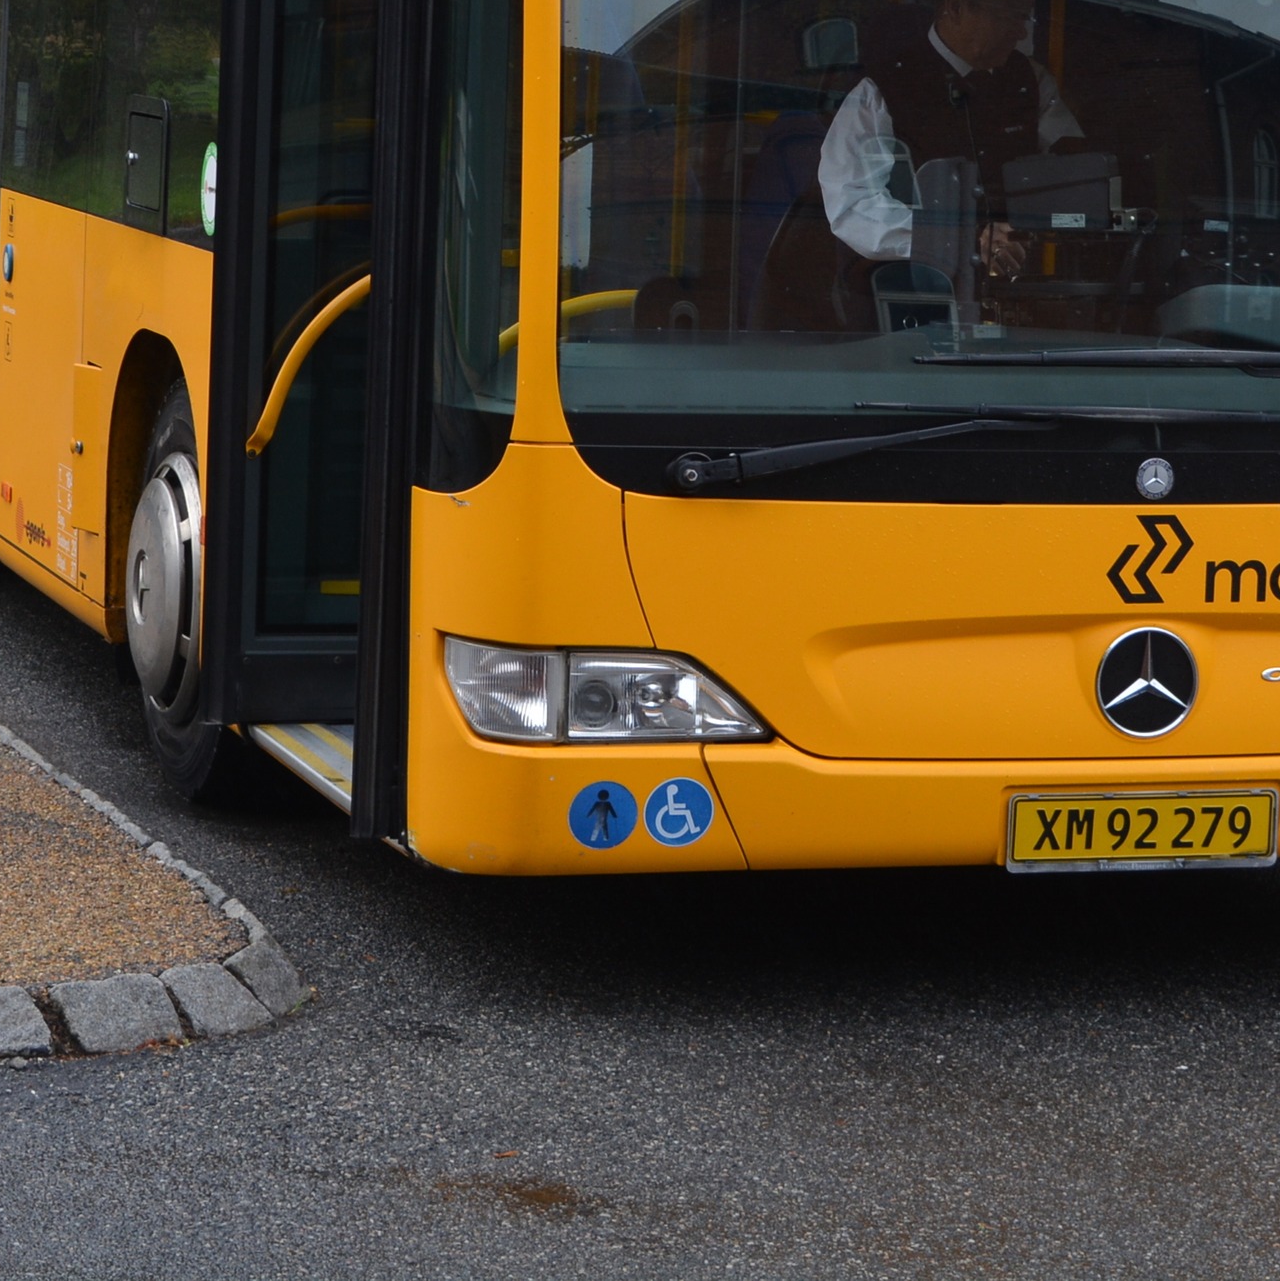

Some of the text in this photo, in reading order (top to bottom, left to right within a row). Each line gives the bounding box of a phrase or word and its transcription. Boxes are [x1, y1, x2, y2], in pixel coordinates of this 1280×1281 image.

[1032, 805, 1252, 851] XM 92 279
